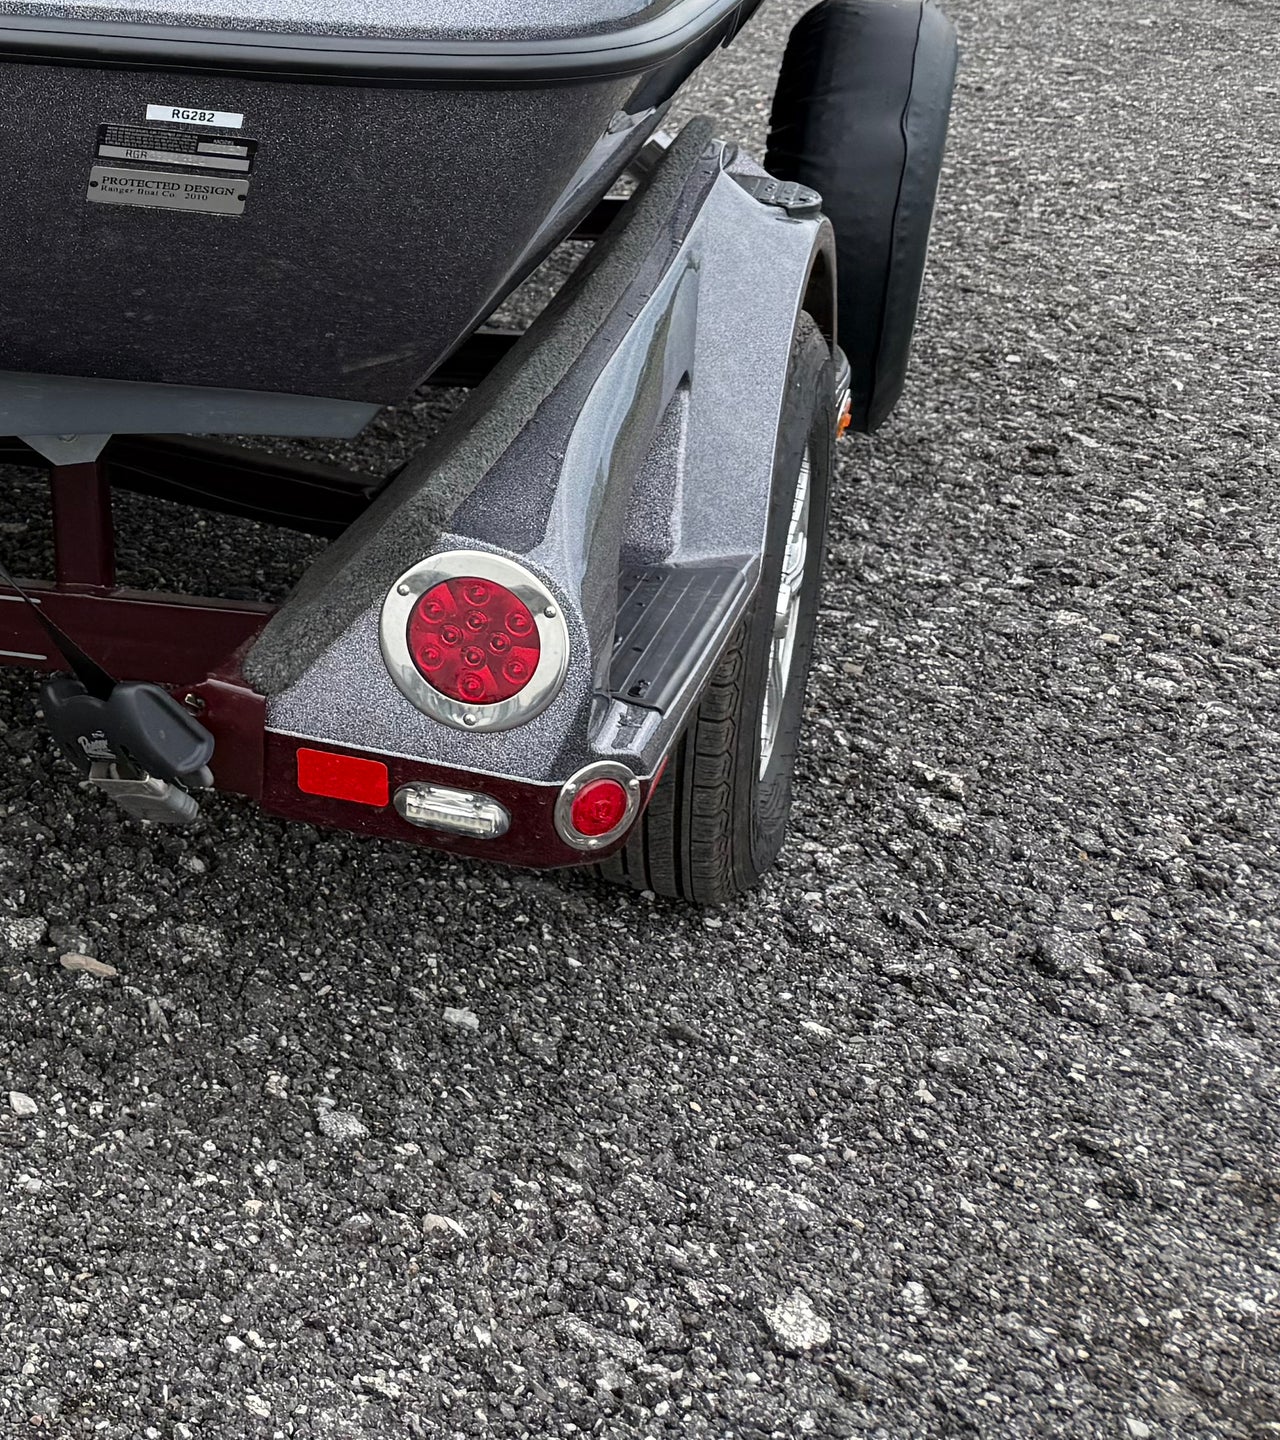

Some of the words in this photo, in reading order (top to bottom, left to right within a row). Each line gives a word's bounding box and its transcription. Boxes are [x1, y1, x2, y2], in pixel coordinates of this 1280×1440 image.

[171, 108, 215, 123] RG282
[100, 185, 135, 195] Ranger
[184, 192, 209, 201] 2010
[101, 175, 181, 191] PROTECTED
[184, 183, 236, 196] DESIGN
